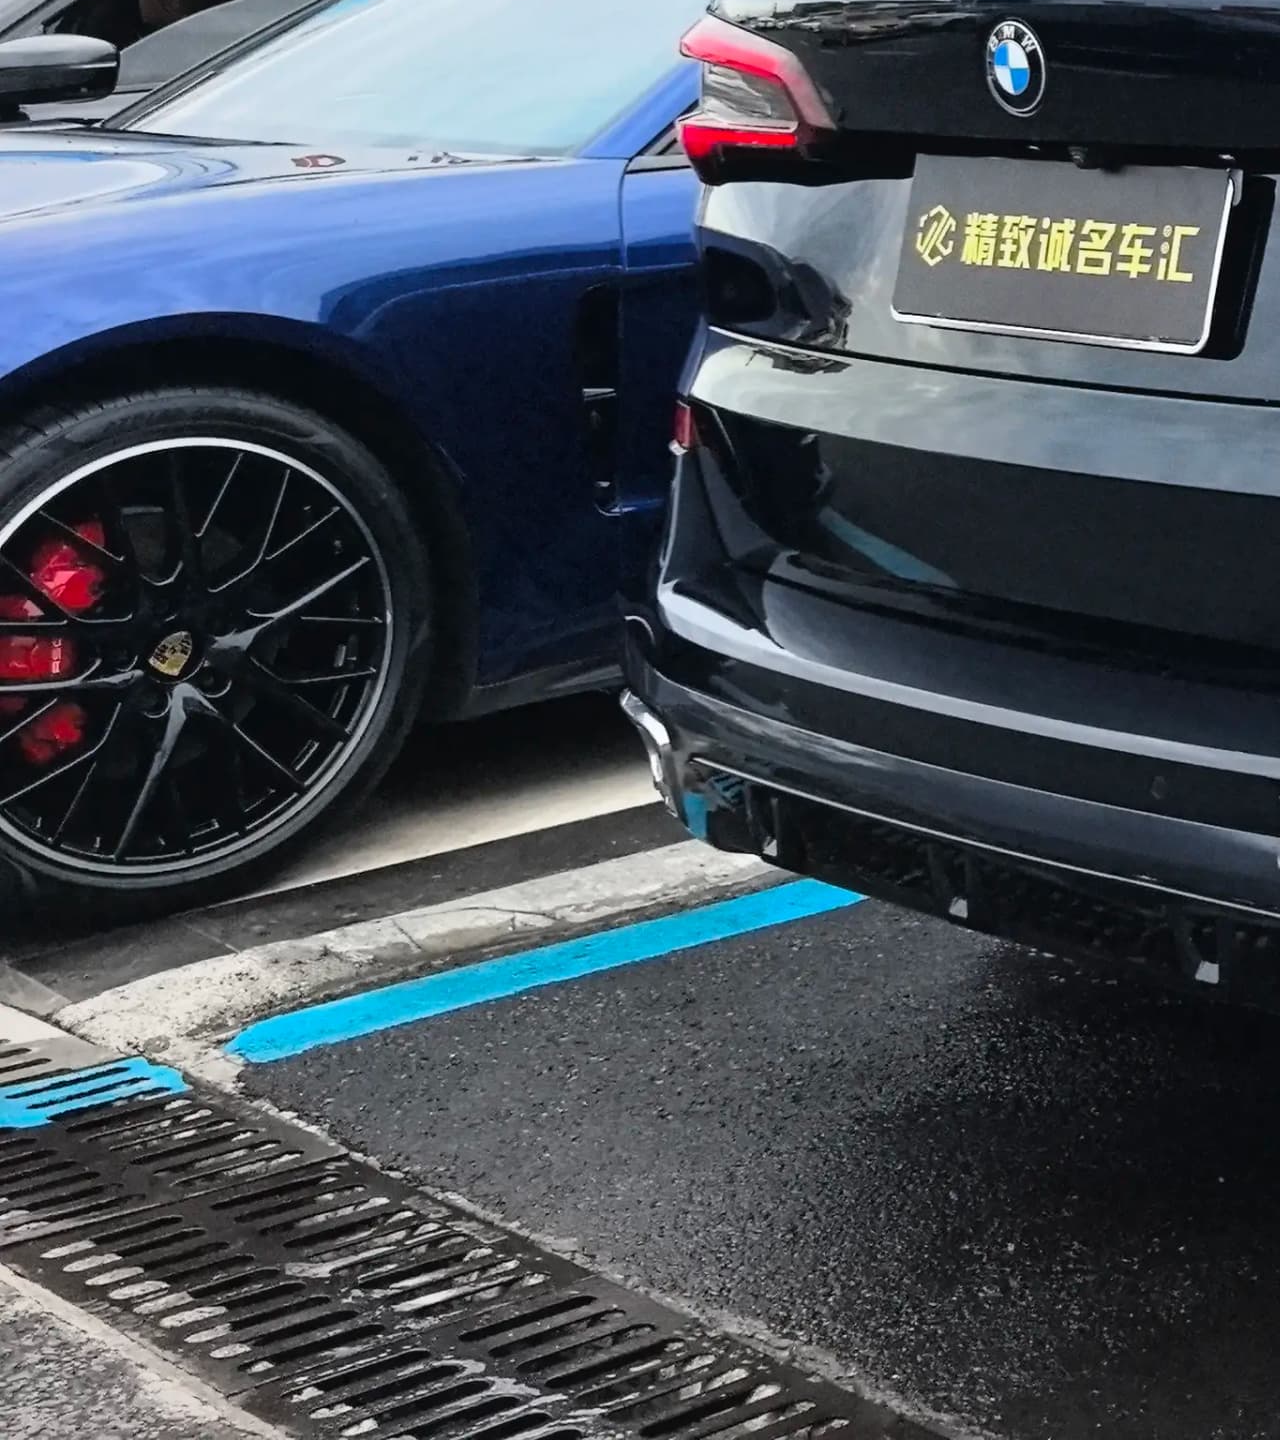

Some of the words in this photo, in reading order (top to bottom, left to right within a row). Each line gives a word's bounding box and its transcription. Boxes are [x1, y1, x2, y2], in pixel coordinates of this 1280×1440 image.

[988, 25, 1037, 53] BMW
[960, 212, 1200, 282] 精致诚名车汇
